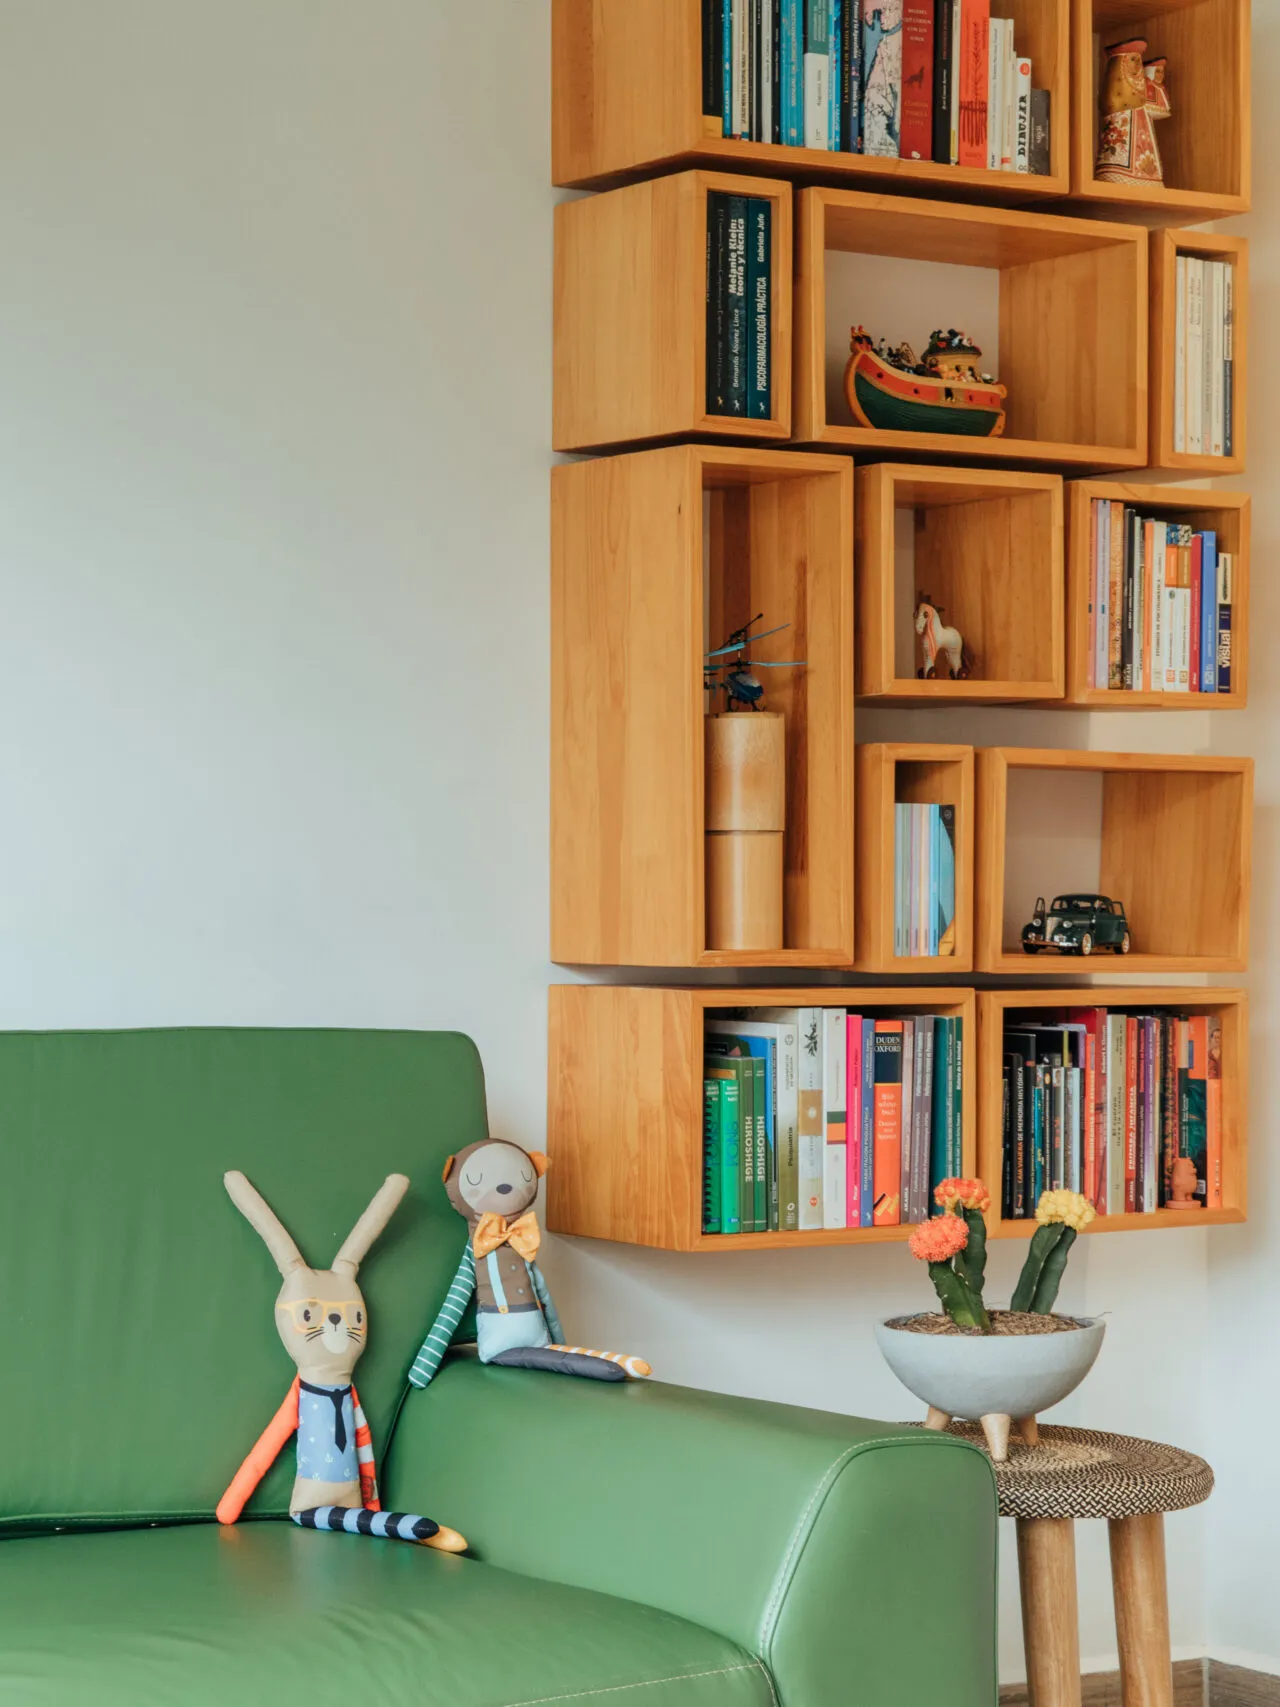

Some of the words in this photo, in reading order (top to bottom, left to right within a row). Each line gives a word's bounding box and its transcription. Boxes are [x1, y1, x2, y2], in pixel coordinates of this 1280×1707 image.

[1017, 94, 1028, 157] DIBUJAR
[729, 219, 737, 250] Klein:
[736, 218, 744, 255] técnica
[757, 213, 765, 231] Jufe
[738, 256, 746, 264] y
[757, 231, 765, 262] Gabriela
[728, 252, 737, 294] Melanie
[736, 266, 744, 297] teoría
[754, 277, 767, 313] PRÁCTICA
[732, 328, 740, 354] Álvarez
[755, 314, 767, 391] PSICOFARMACOLOGÍA
[1218, 629, 1231, 667] visual
[876, 1036, 900, 1044] DUDEN
[1016, 1066, 1024, 1100] HISTÓRICA
[725, 1120, 739, 1167] PONS
[745, 1115, 753, 1182] HIROSHIGE
[757, 1115, 766, 1182] HIROSHIGE
[1017, 1133, 1024, 1141] DE
